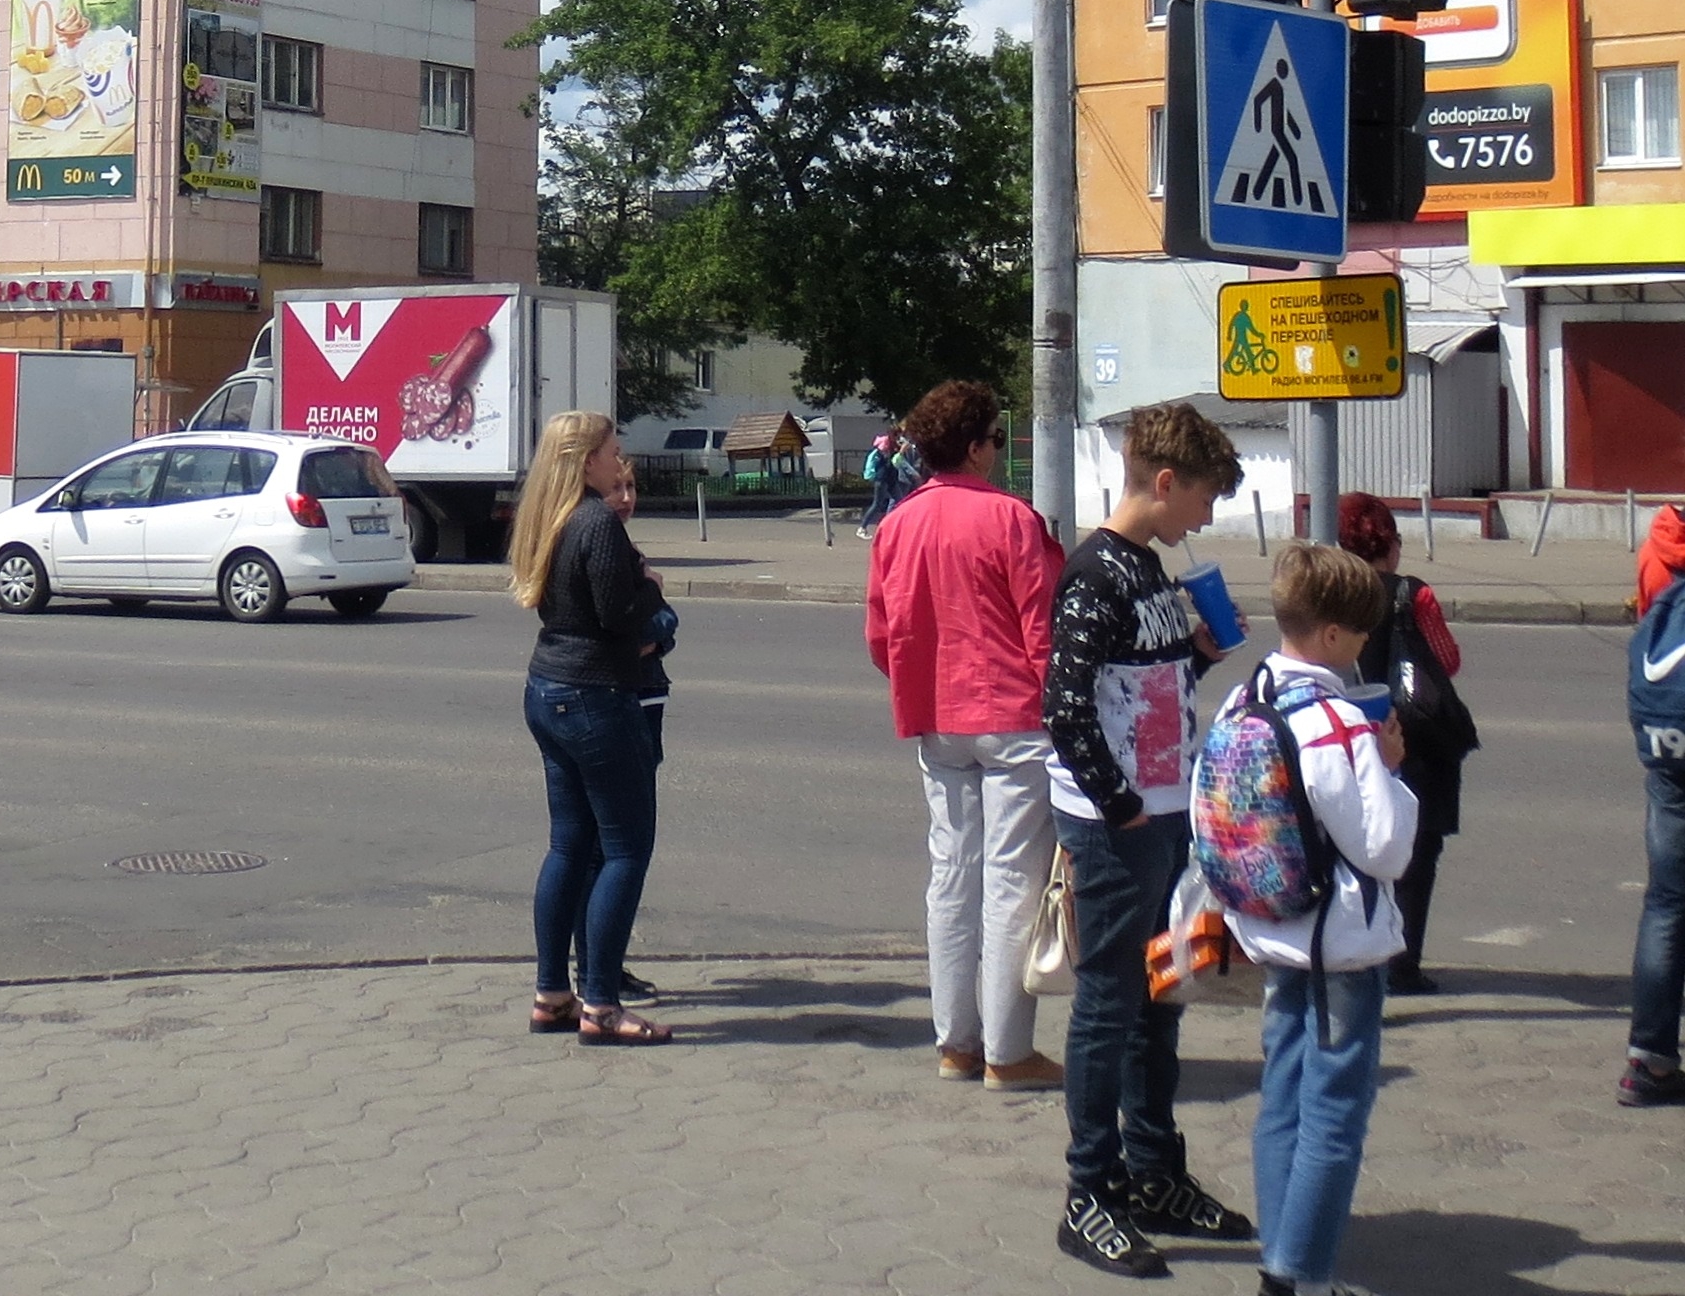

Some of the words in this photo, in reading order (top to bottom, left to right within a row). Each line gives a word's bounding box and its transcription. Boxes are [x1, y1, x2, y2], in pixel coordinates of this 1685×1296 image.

[1416, 15, 1461, 30] ДОБАВИТЬ
[1428, 103, 1531, 126] dodopizza.by
[1458, 133, 1533, 169] 7576
[63, 168, 82, 184] 50
[1426, 191, 1477, 204] одробности
[1270, 292, 1365, 309] СПЕШИВАЙТЕСЬ
[1271, 314, 1287, 327] НА
[1290, 308, 1379, 325] ПЕШЕХОДНОМ
[1271, 328, 1334, 344] ПЕРЕХОДЕ
[1096, 358, 1116, 381] 39
[1271, 376, 1301, 387] РАДИО
[1304, 374, 1348, 386] МОГИЛЕВ
[1369, 373, 1383, 384] FM
[305, 407, 378, 425] ДЕЛАЕМ
